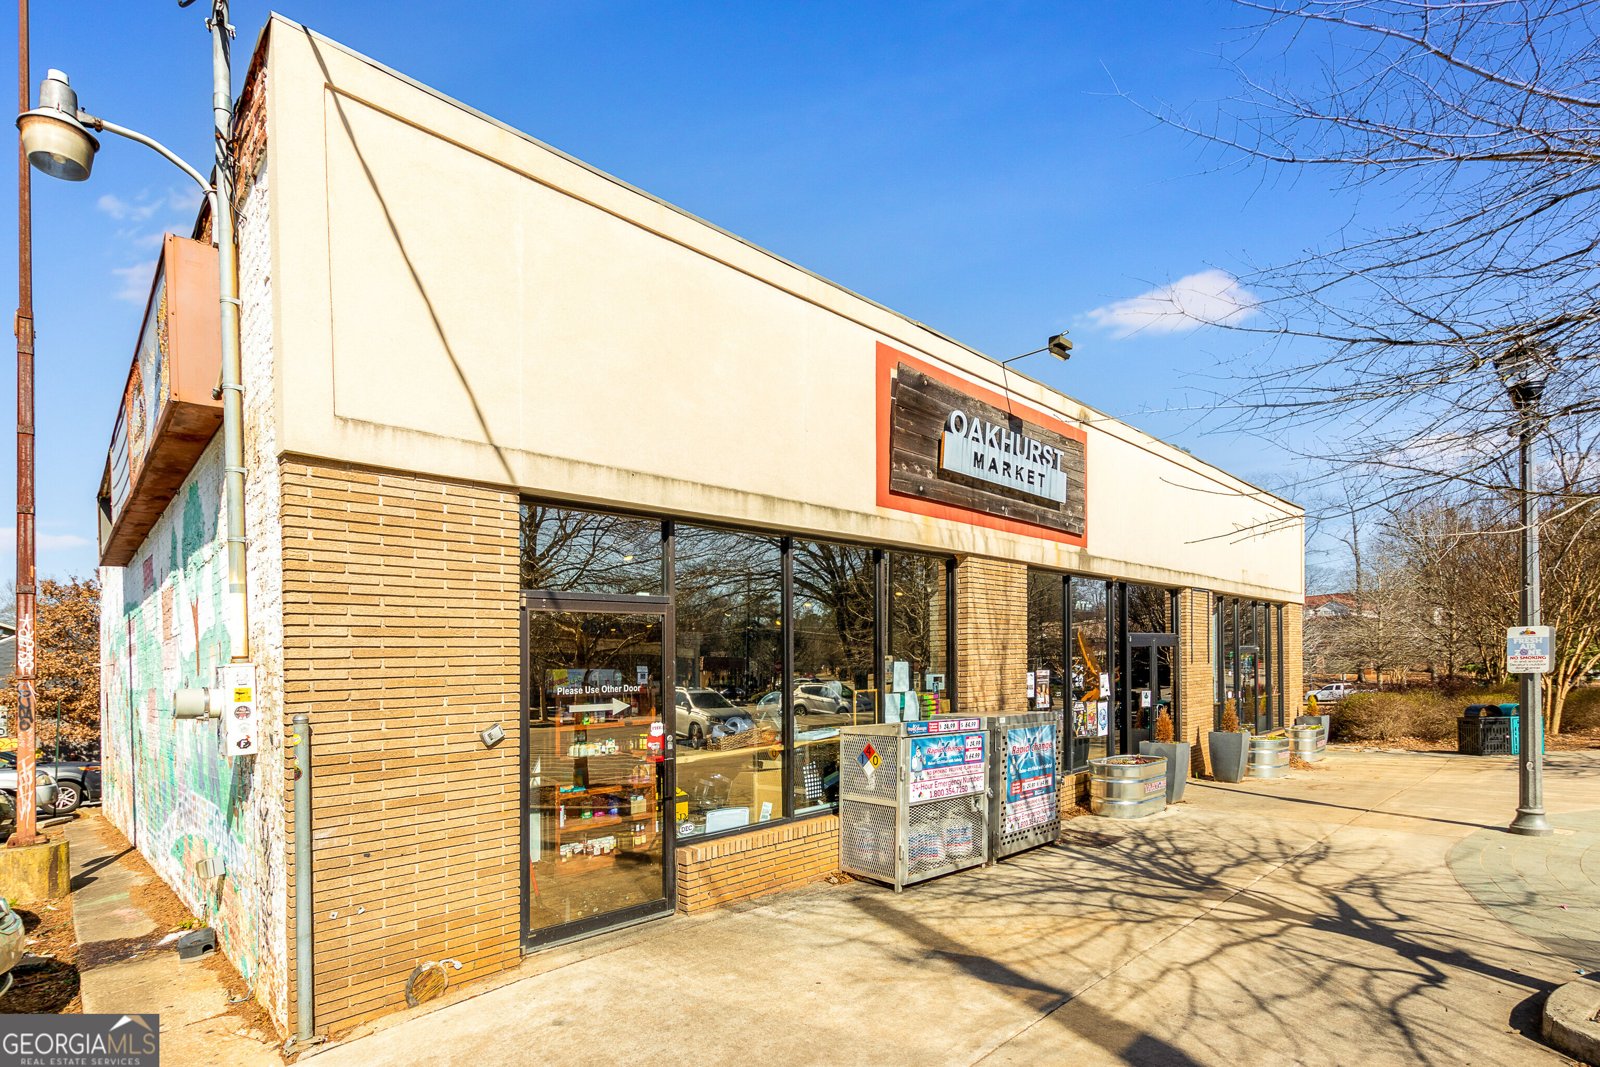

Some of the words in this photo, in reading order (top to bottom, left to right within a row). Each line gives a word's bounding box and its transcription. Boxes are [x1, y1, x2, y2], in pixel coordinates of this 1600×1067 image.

[949, 409, 1065, 471] OAKHURST
[973, 451, 1046, 488] MARKET
[557, 687, 583, 696] Please
[585, 685, 600, 694] Use
[601, 684, 622, 693] Other
[623, 684, 641, 692] Door
[866, 746, 871, 756] 4
[873, 755, 878, 766] 0
[912, 782, 933, 792] 24-Hour
[934, 778, 962, 789] Emergency
[681, 825, 693, 833] DEC
